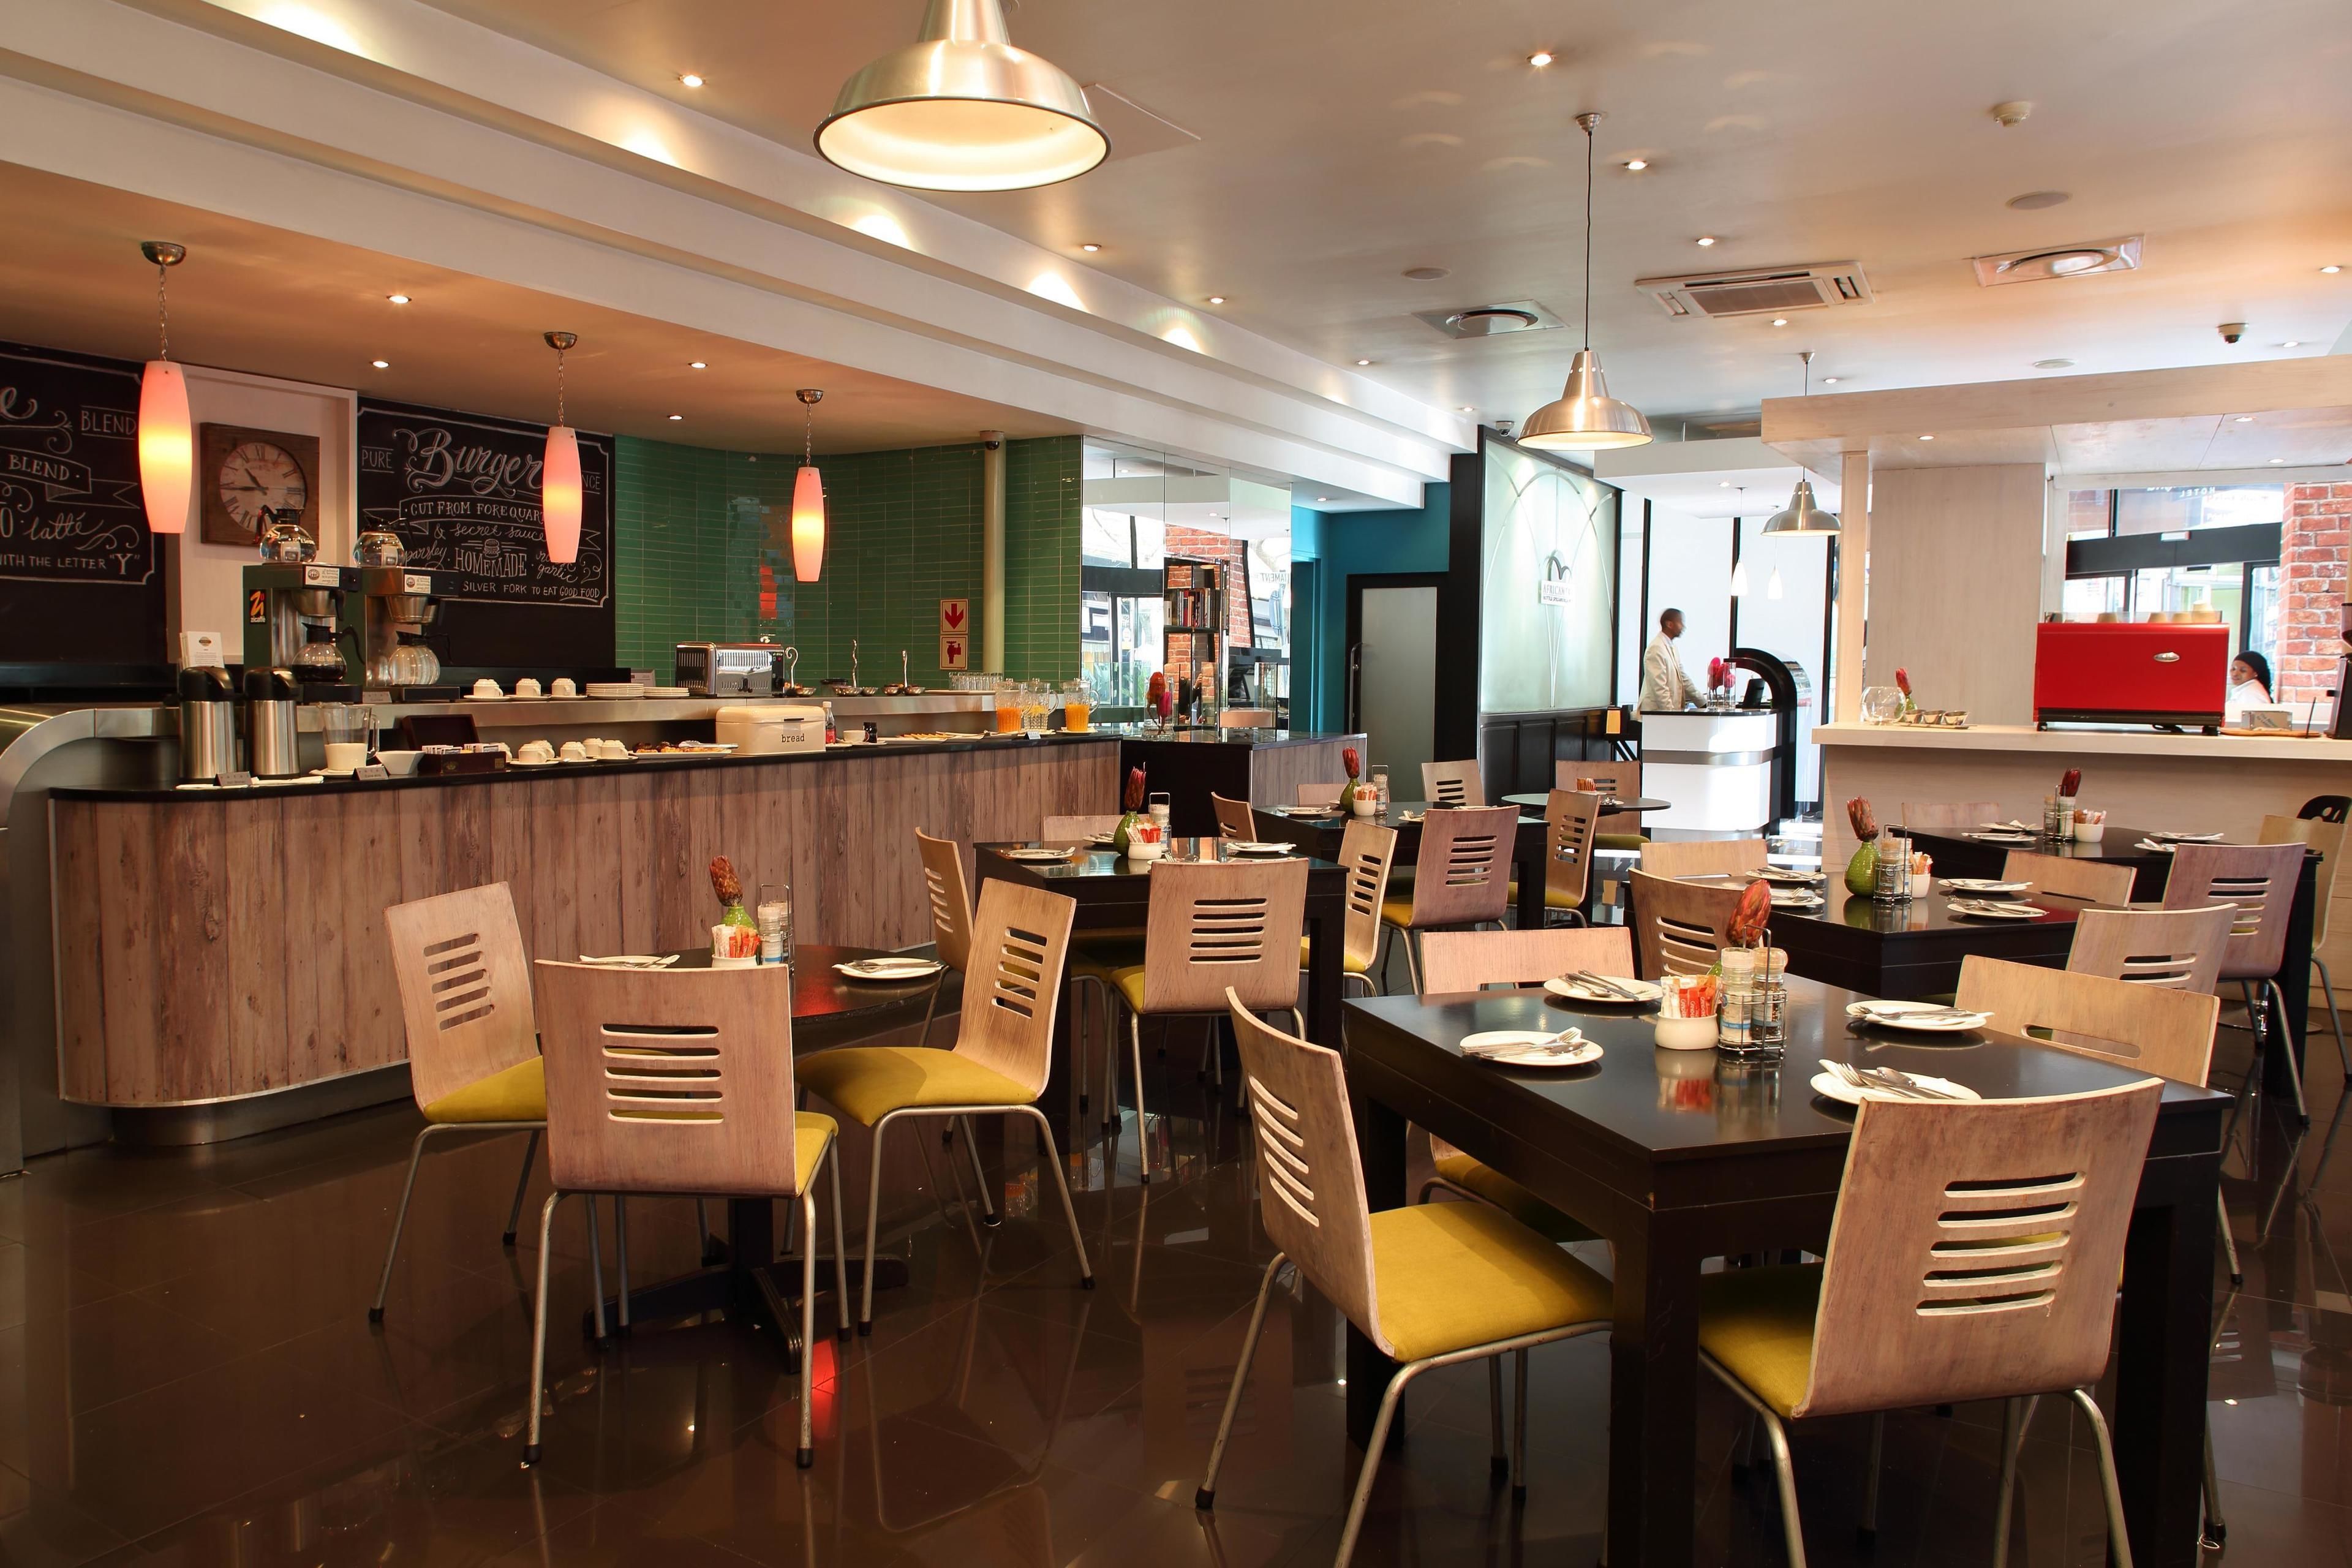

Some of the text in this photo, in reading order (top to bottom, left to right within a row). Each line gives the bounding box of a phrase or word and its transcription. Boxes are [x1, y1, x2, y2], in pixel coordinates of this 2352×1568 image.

[81, 410, 137, 435] BLEND
[9, 454, 69, 481] BLEND
[362, 449, 393, 469] PURE
[393, 428, 543, 498] Burger
[410, 502, 434, 517] CUT
[437, 502, 471, 516] FROM
[450, 523, 502, 538] secret
[506, 527, 547, 542] sauce
[29, 556, 51, 568] THE
[58, 557, 107, 570] LETTER
[405, 540, 447, 570] parsley
[454, 548, 527, 578] HOMEMADE
[537, 562, 579, 583] garlic
[463, 581, 600, 599] SILVER FORK TO EAT GOOD FOOD
[782, 734, 805, 743] bread
